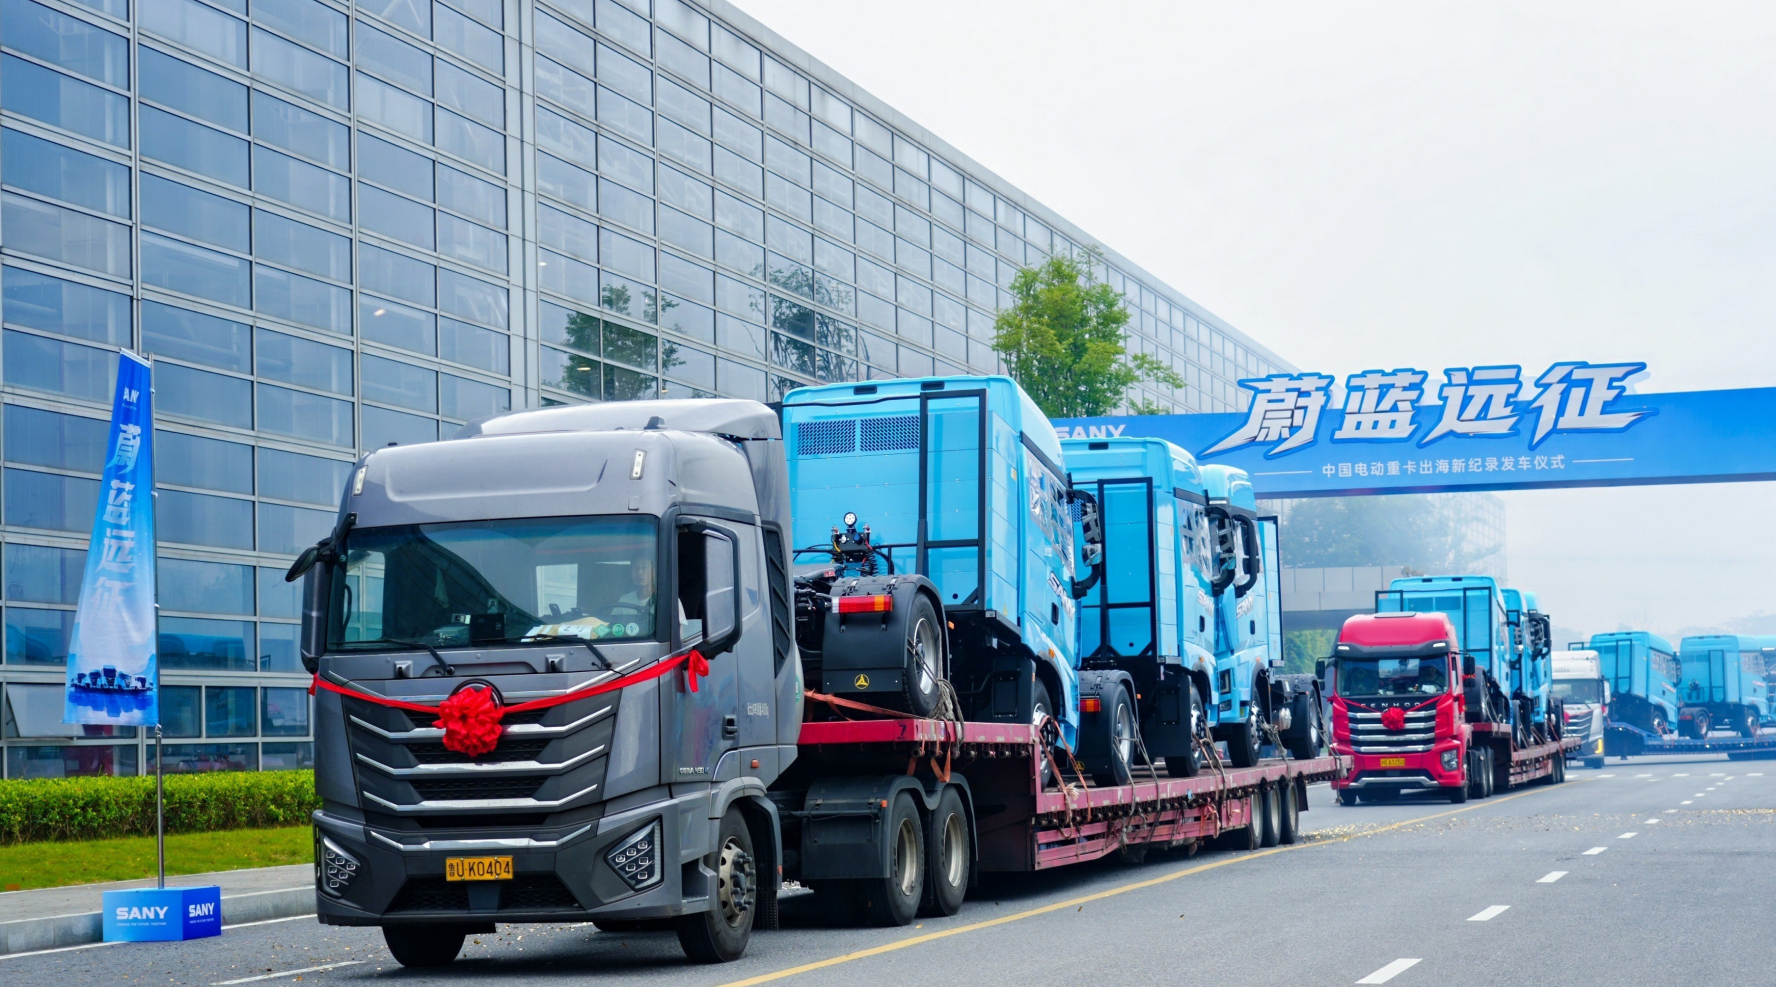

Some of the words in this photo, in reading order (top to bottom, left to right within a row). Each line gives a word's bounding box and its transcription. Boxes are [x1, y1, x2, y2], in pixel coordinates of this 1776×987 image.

[1199, 364, 1656, 457] 蔚蓝远征
[1054, 424, 1127, 440] SANY
[1322, 454, 1566, 478] 中国电动重卡出海新纪录发车仪式
[92, 422, 142, 606] 蔚蓝远征
[115, 906, 169, 920] SANY
[188, 902, 215, 918] SANY
